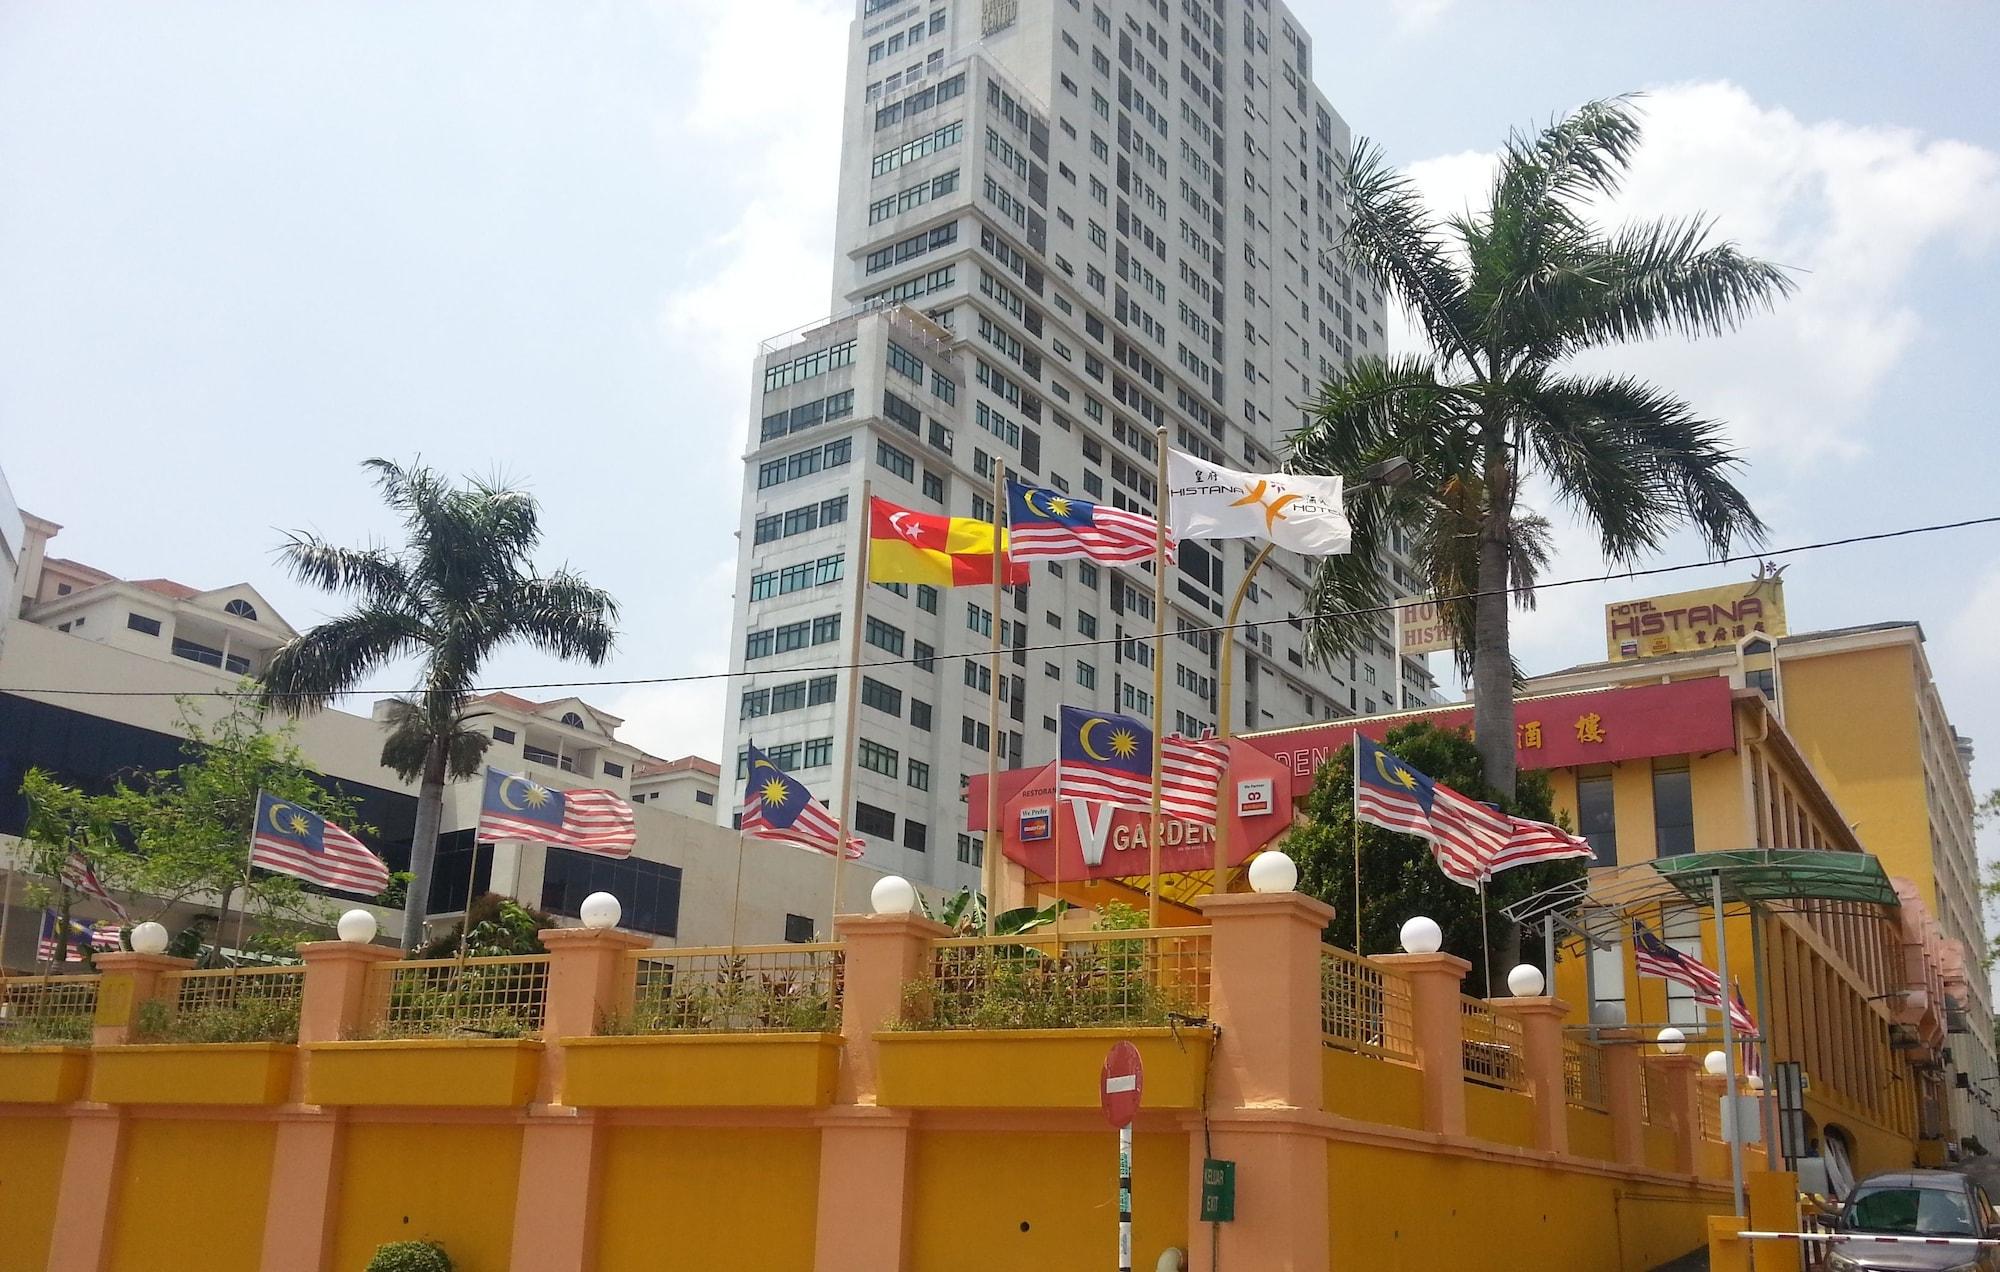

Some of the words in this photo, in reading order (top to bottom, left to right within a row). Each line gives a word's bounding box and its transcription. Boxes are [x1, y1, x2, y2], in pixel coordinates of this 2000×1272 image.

[1170, 485, 1244, 497] HISTANA
[1611, 600, 1656, 617] HOTEL
[1611, 597, 1763, 640] HISTANA
[1071, 799, 1116, 867] V
[1207, 1195, 1219, 1212] EXIT
